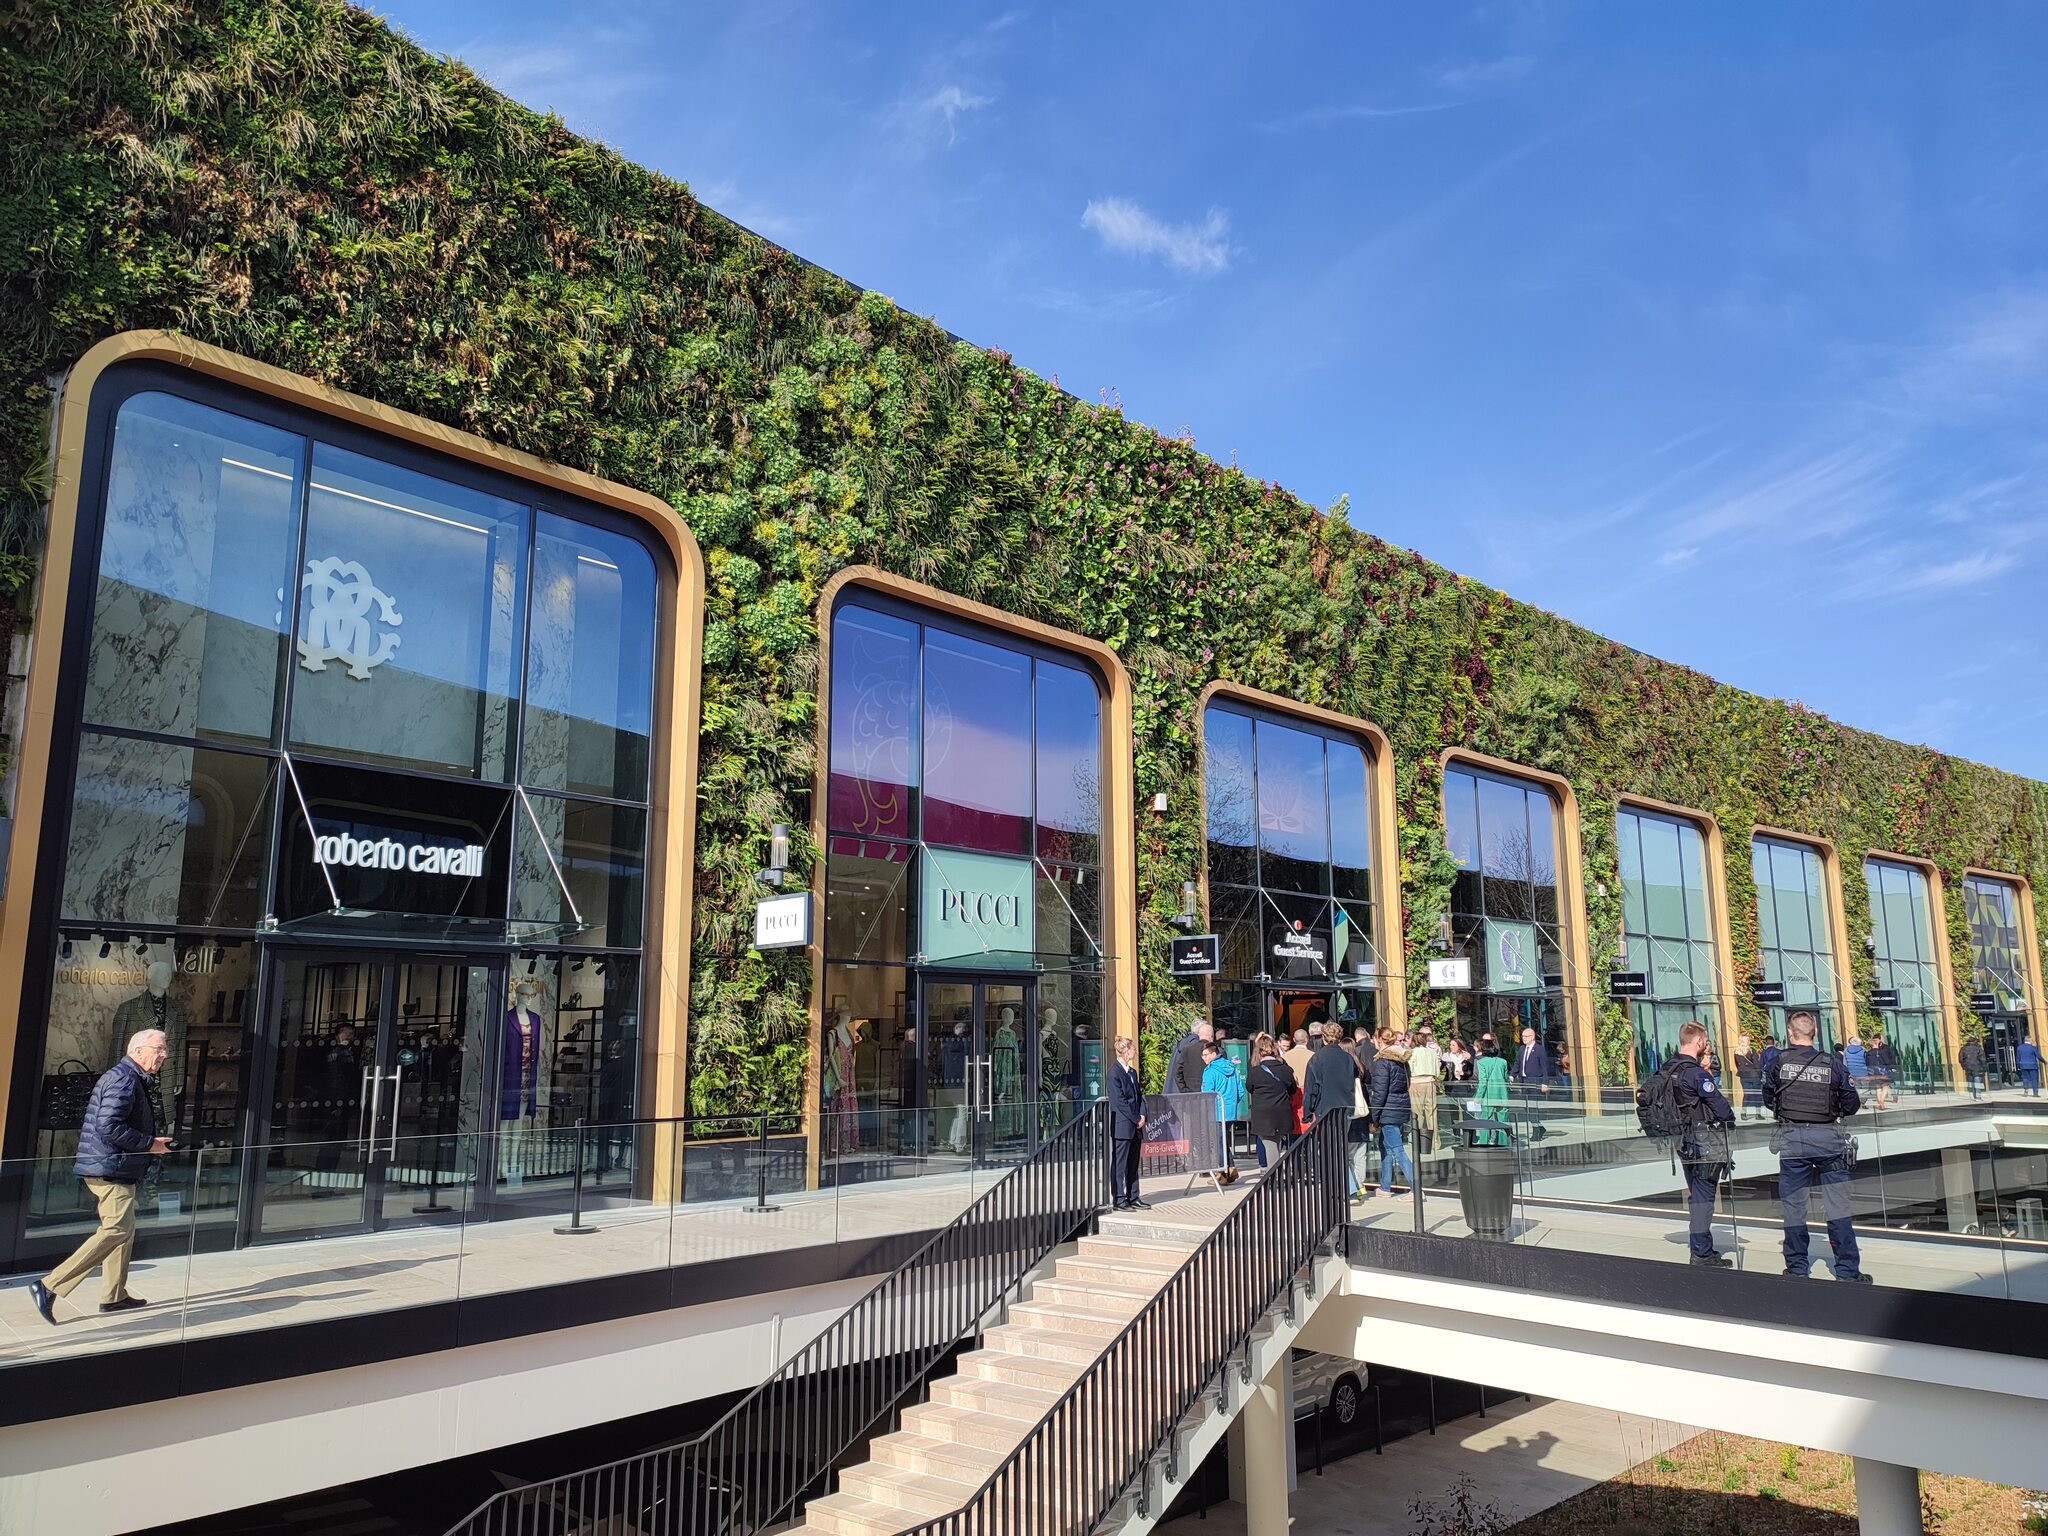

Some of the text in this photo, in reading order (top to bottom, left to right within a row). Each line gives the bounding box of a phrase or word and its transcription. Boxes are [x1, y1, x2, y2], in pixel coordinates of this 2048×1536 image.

[312, 832, 483, 877] roberto cavalli
[938, 888, 1020, 927] PUCCI
[765, 913, 797, 930] PUCCI
[1788, 1071, 1821, 1082] PSIG
[1145, 1110, 1173, 1133] McArthur
[1147, 1128, 1163, 1141] Glen
